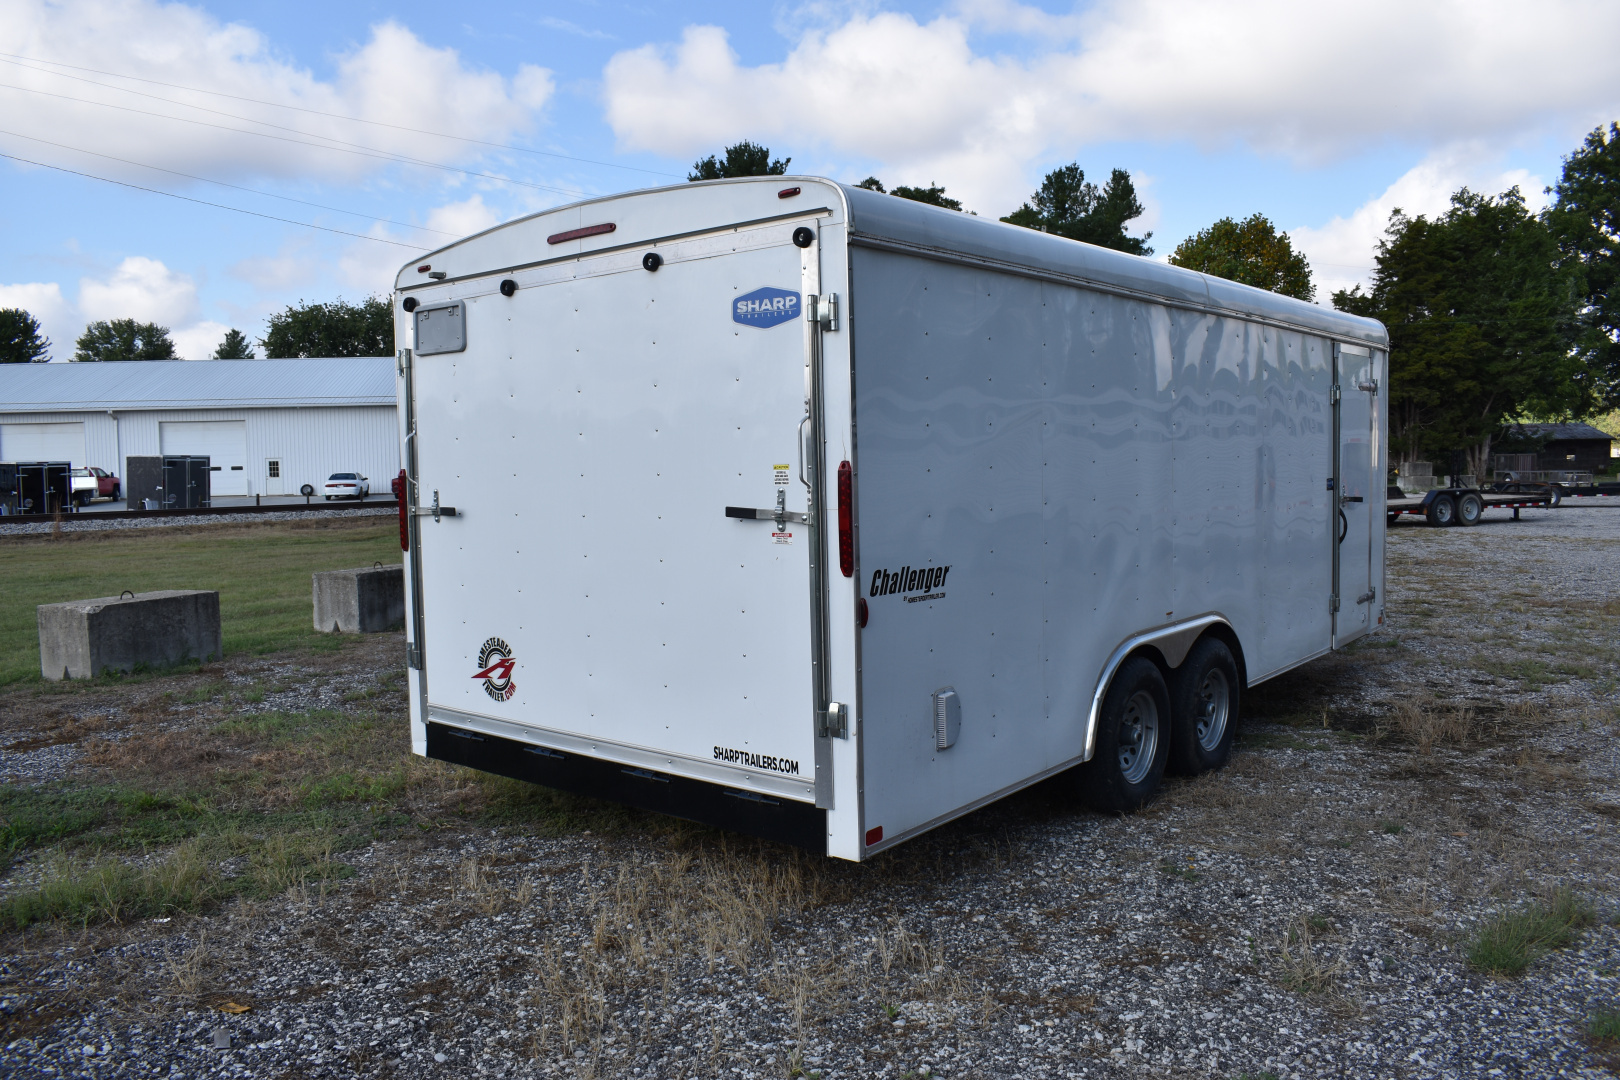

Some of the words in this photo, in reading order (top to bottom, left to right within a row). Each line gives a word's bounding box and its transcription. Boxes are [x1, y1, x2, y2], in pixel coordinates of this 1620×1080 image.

[737, 296, 797, 313] SHARP
[741, 310, 792, 319] TRAILERS
[870, 566, 950, 597] Challenger
[478, 637, 512, 669] HOMESTEADER
[713, 745, 799, 775] SHARPTRAILERS.COM
